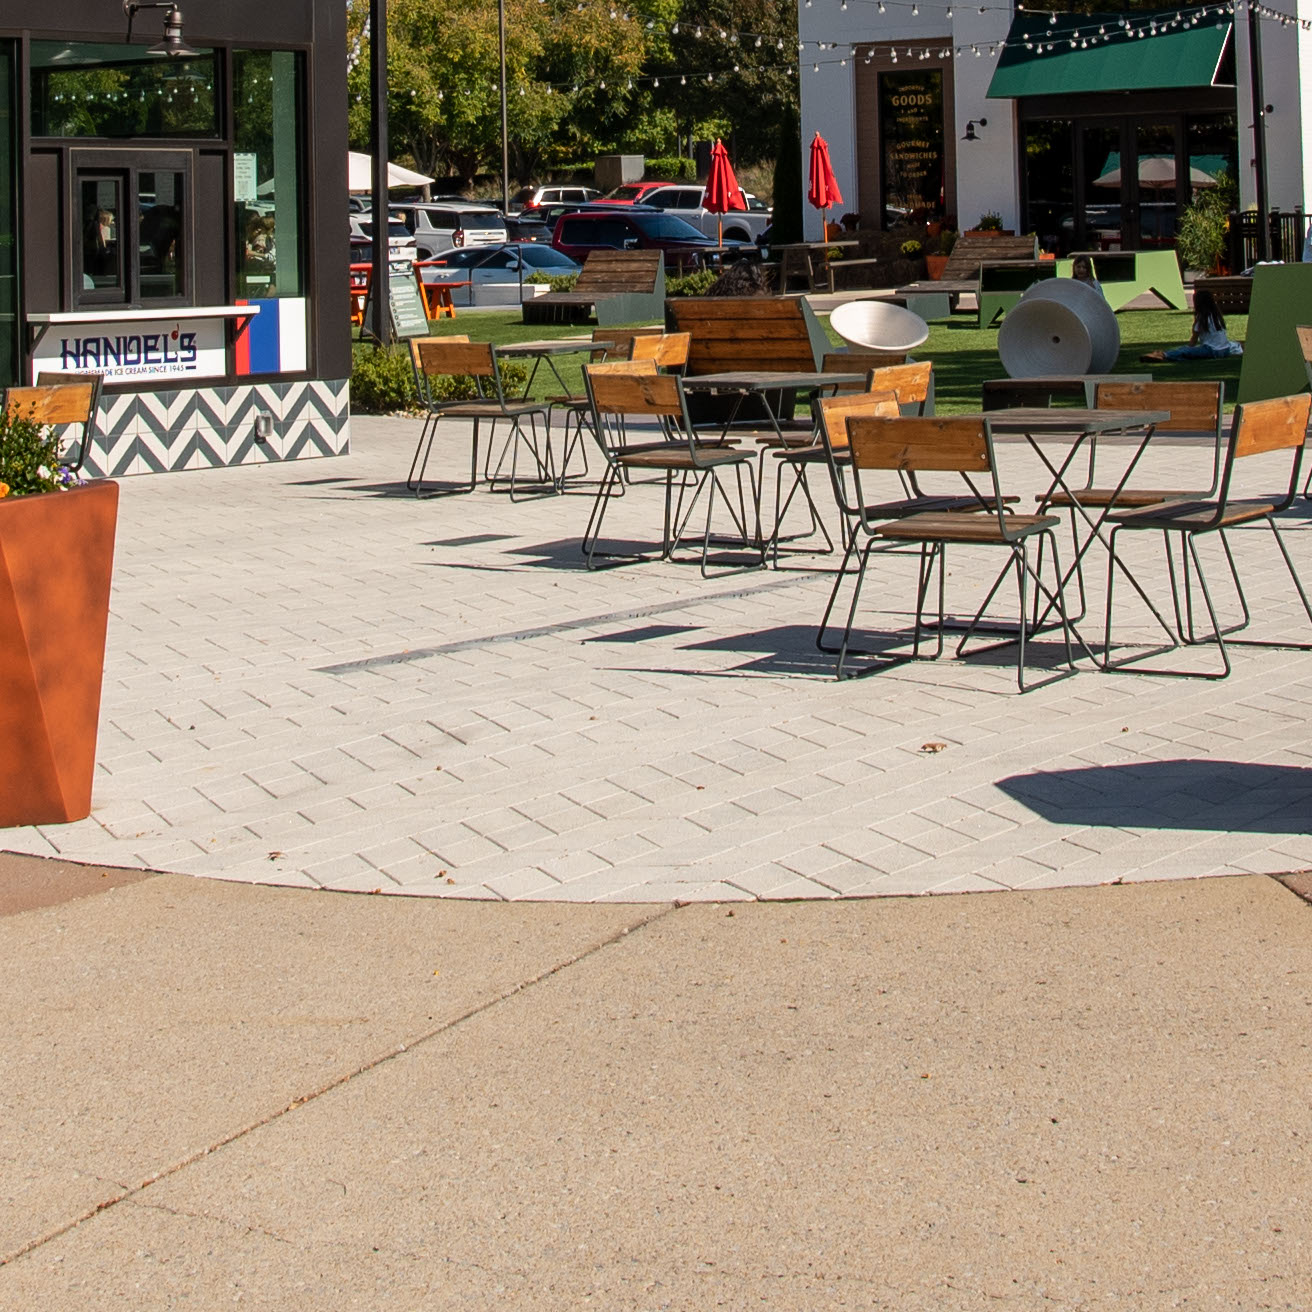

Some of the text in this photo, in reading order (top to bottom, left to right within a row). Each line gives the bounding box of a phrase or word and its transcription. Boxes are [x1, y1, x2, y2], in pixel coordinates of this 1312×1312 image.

[891, 93, 933, 107] GOODS
[60, 325, 197, 370] HANDEL'S
[114, 368, 124, 376] ICE
[125, 367, 148, 375] CREAM
[148, 365, 167, 374] SINCE
[169, 364, 185, 373] 1945
